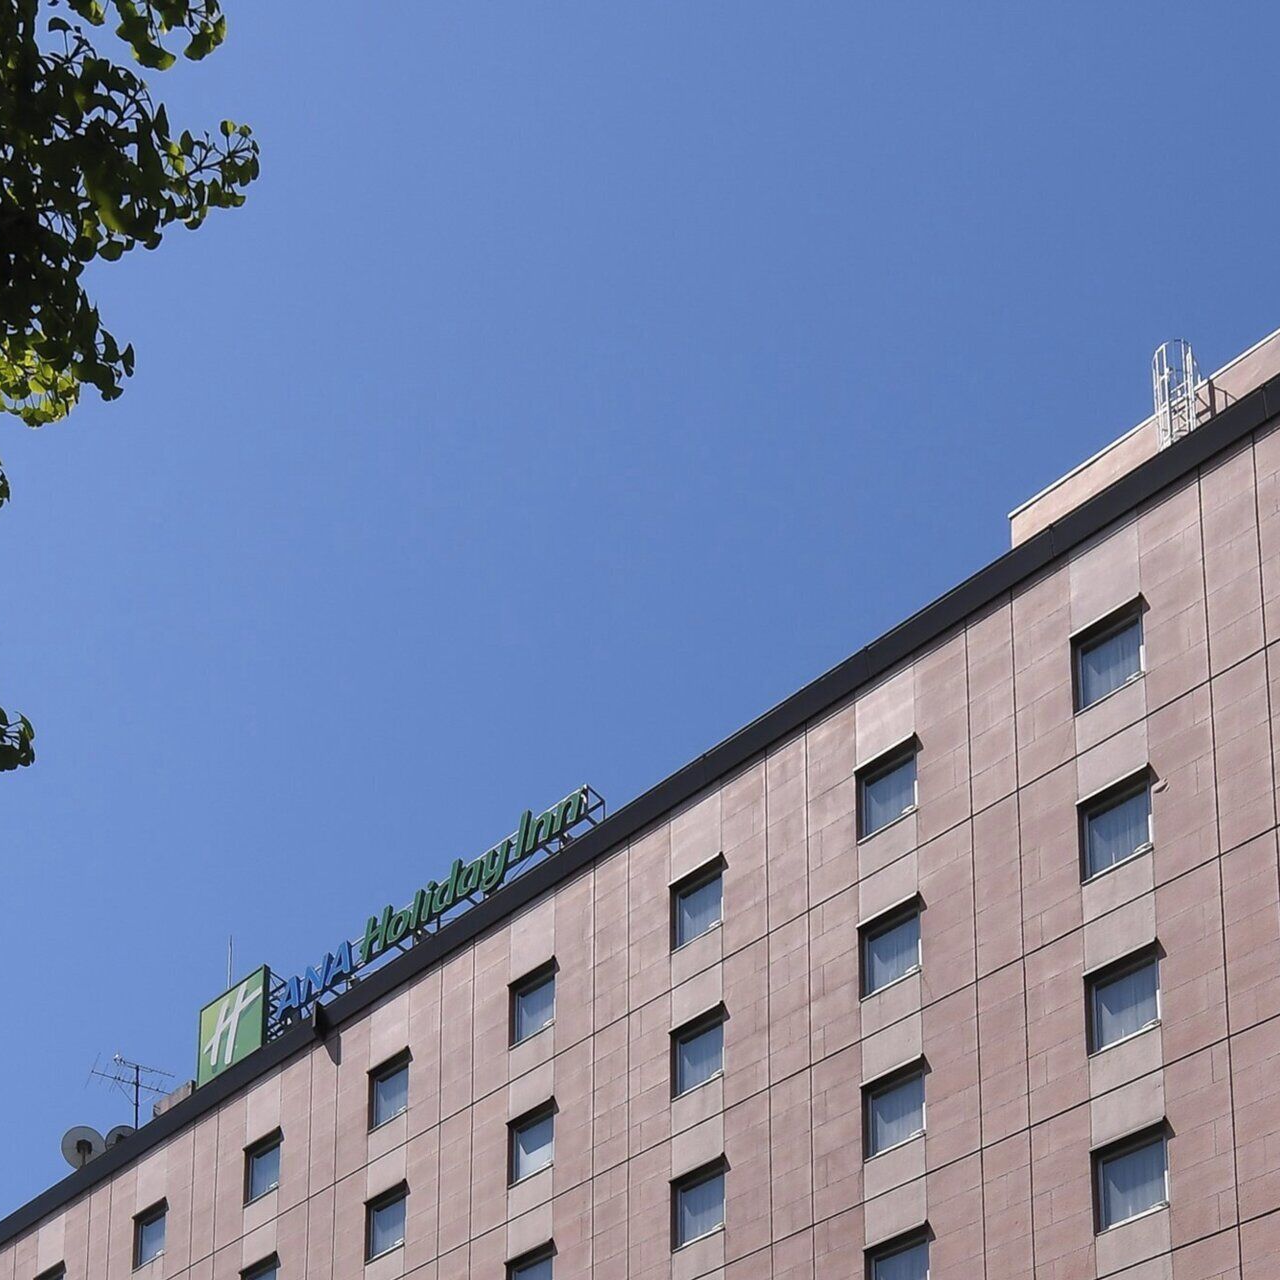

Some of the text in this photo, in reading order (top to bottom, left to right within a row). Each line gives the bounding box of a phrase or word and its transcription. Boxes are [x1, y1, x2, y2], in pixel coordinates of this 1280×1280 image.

[276, 787, 587, 1019] ANA Holiday Inn
